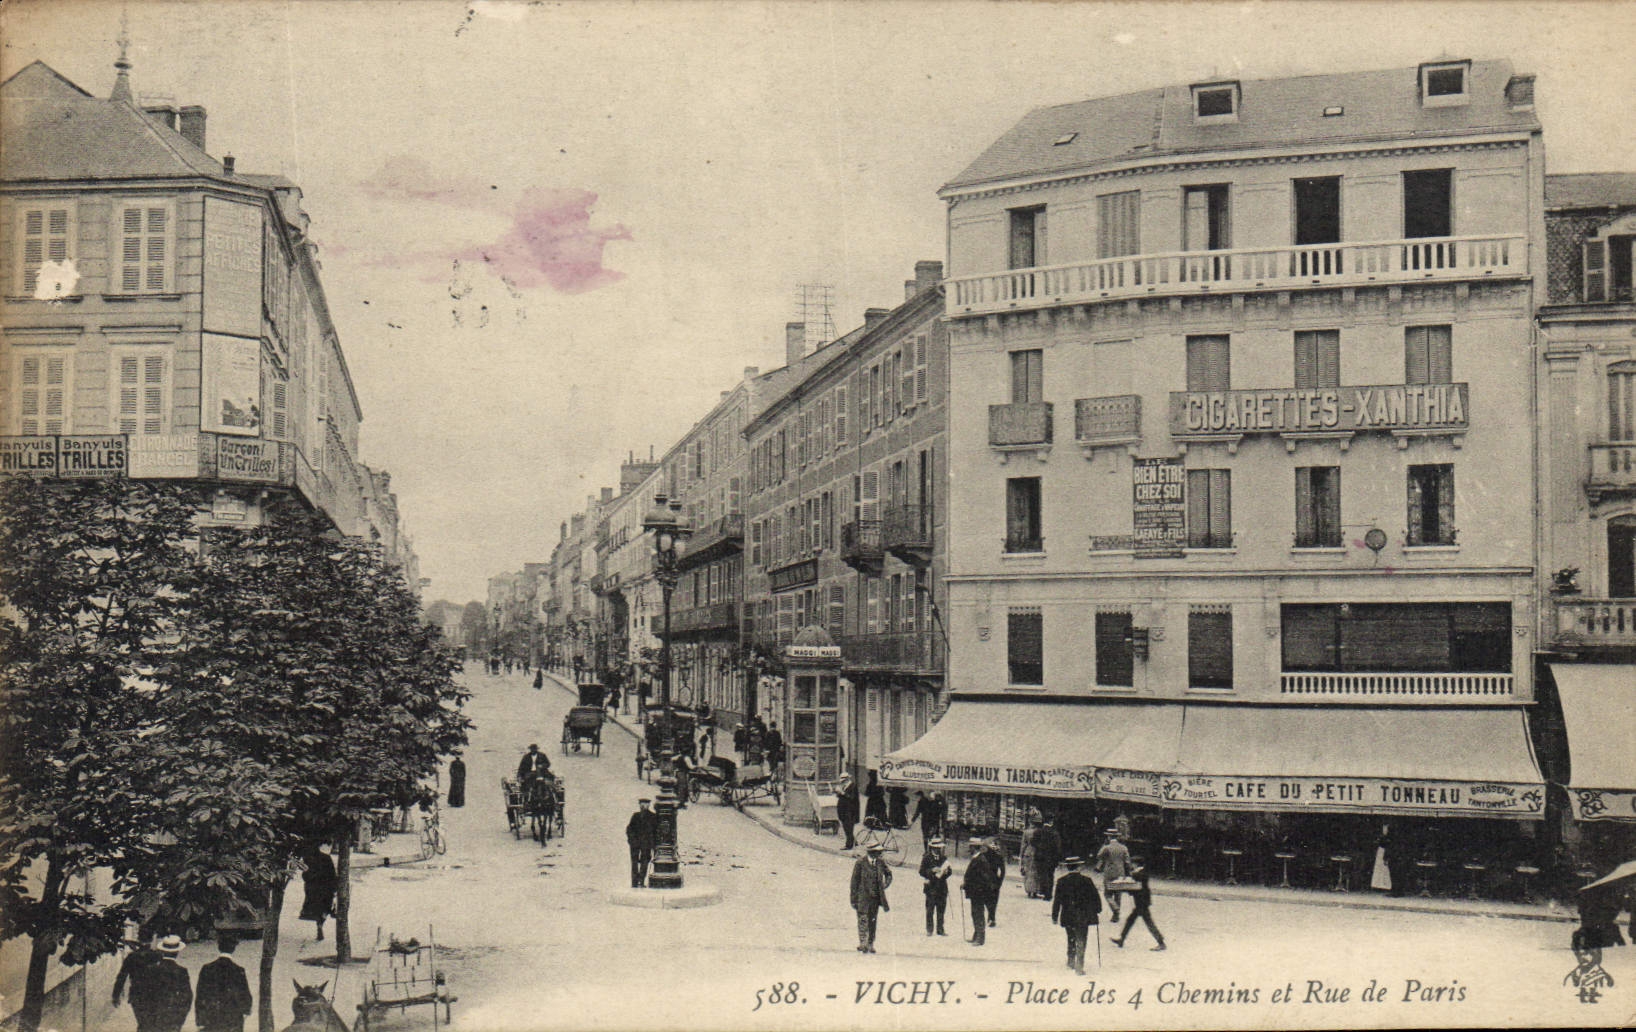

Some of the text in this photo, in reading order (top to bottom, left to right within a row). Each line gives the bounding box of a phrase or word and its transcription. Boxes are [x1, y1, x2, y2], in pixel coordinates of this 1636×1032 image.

[0, 439, 52, 452] anyuls
[63, 438, 123, 452] Banyuls
[220, 438, 265, 456] Garçon!
[62, 450, 125, 469] TRILLES
[1134, 466, 1157, 484] BIEN
[1136, 484, 1181, 499] CHEZ SOI
[943, 764, 1047, 785] JOURNAUX TABACS
[1183, 788, 1218, 799] TOURTEL
[1226, 782, 1461, 804] CAFE DU PETIT TONNEAU
[1470, 783, 1516, 797] BRASSERIE
